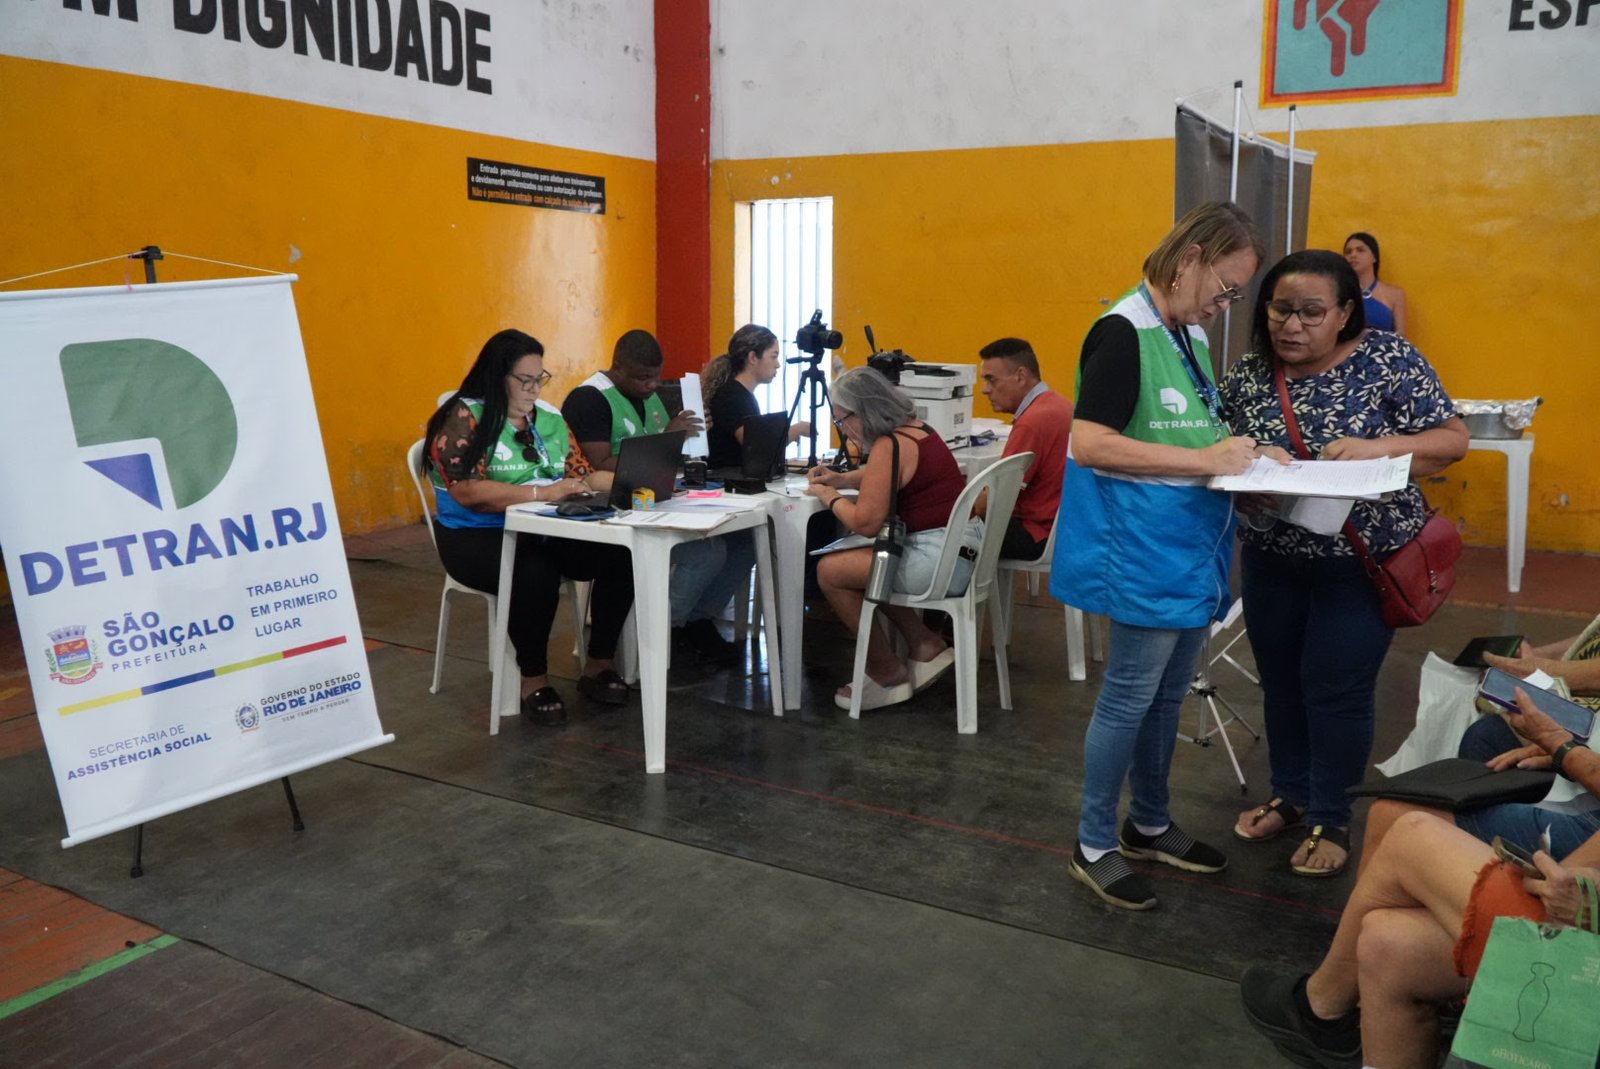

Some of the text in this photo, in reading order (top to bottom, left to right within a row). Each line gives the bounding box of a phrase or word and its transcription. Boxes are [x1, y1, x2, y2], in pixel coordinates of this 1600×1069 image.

[480, 163, 499, 174] Entrada
[20, 502, 327, 596] DETRAN.RJ
[246, 573, 319, 597] TRABALHO
[250, 589, 337, 618] EM PRIMEIRO
[102, 611, 160, 638] SÃO
[107, 614, 235, 657] GONÇALO
[255, 617, 301, 637] LUGAR
[112, 643, 207, 672] PREFEITURA
[261, 672, 360, 705] GOVERNO DO ESTADO
[263, 680, 362, 717] RIO DE JANEIRO
[67, 732, 212, 780] ASSISTÊNCIA SOCIAL
[89, 724, 185, 758] SECRETARIA DE
